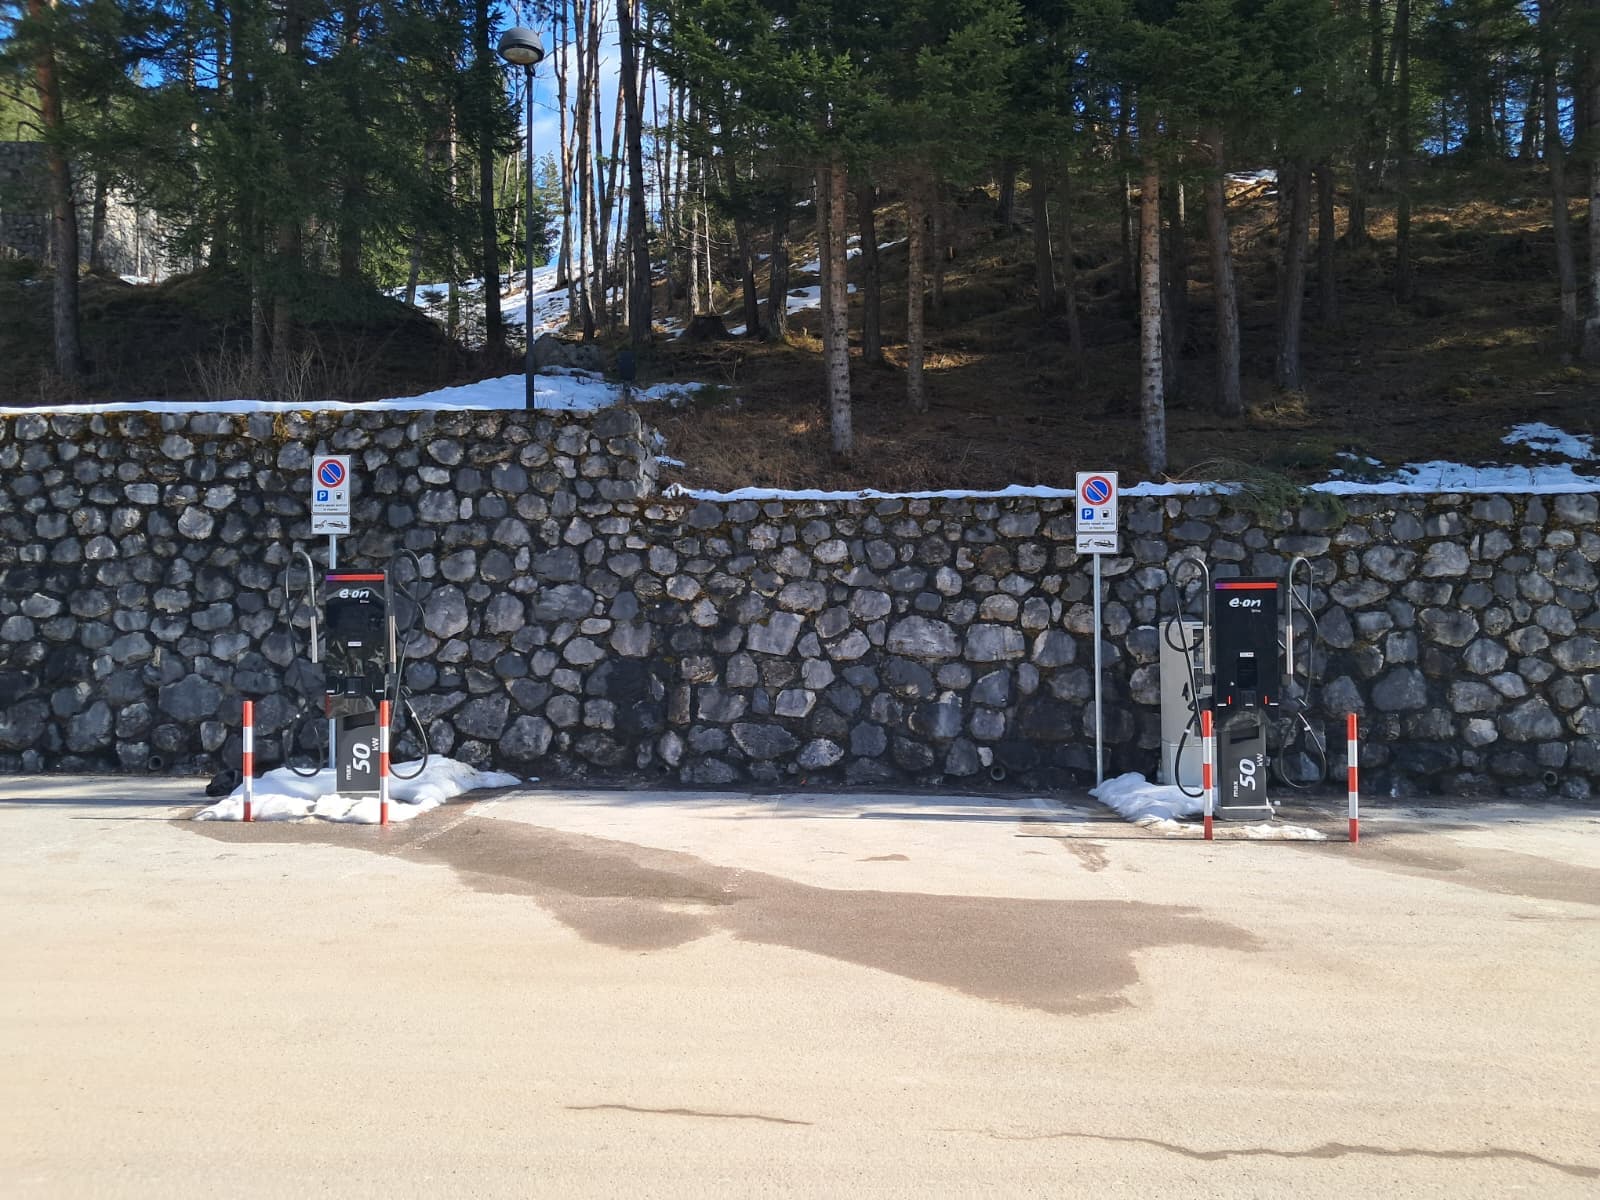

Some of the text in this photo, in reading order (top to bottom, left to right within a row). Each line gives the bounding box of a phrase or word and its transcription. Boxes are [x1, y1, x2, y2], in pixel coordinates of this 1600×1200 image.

[352, 742, 371, 775] 50
[1239, 758, 1256, 791] 50
[1256, 753, 1264, 767] kW
